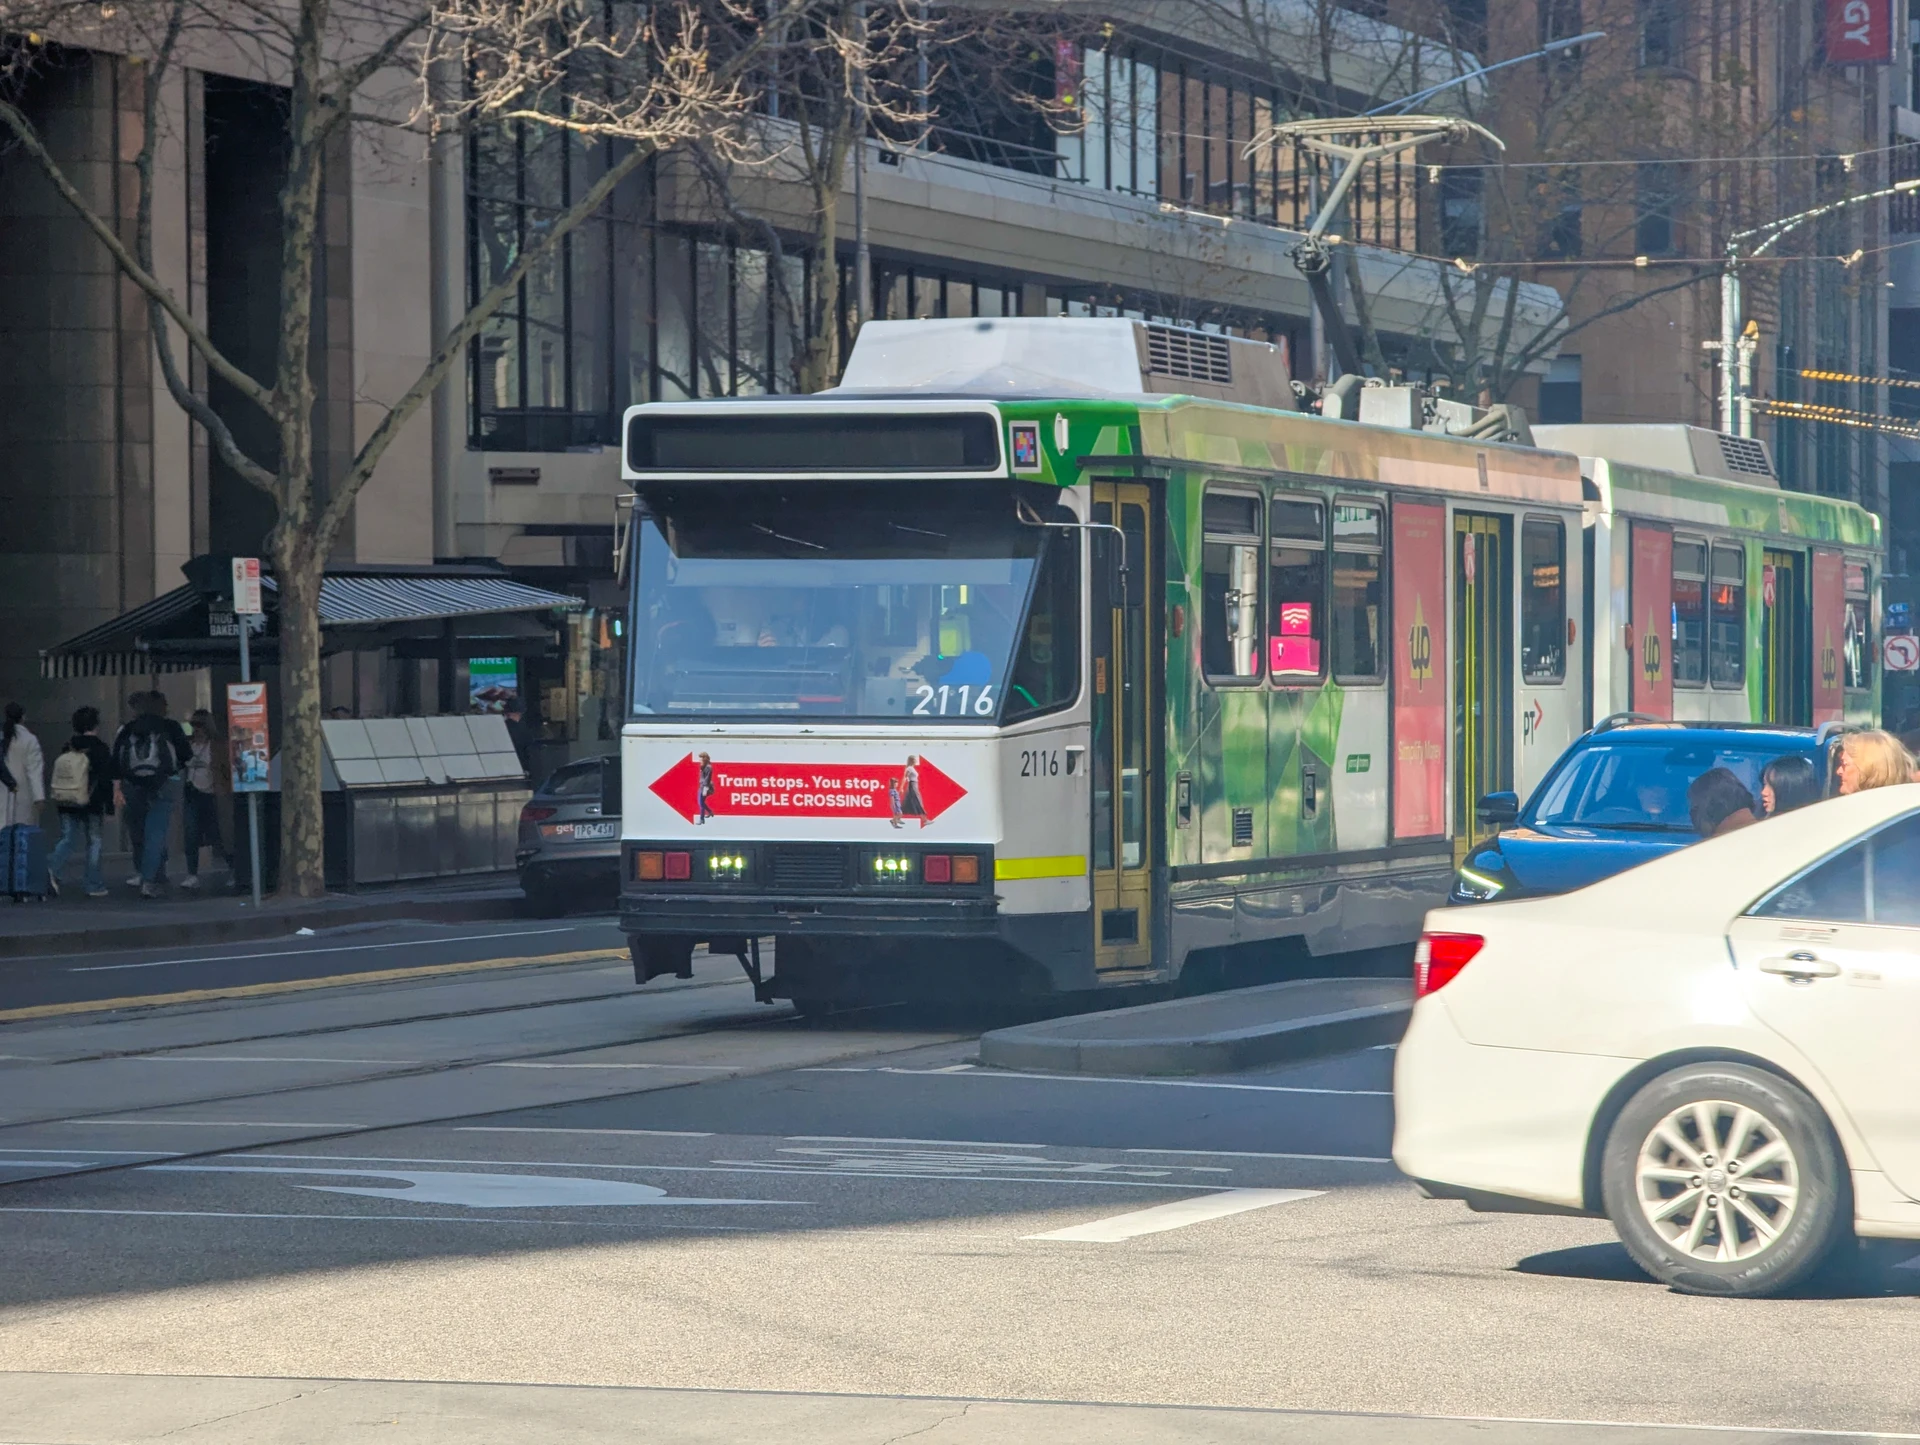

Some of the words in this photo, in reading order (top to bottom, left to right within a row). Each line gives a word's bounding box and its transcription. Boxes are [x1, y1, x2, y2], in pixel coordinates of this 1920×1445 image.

[209, 624, 242, 637] BAKER
[470, 657, 513, 665] INNER
[912, 684, 993, 715] 2116
[1020, 750, 1059, 777] 2116
[717, 774, 758, 788] Tram
[761, 775, 809, 791] stops.
[812, 775, 841, 789] You
[845, 776, 886, 792] stop.
[731, 793, 790, 807] PEOPLE
[793, 793, 873, 808] CROSSING
